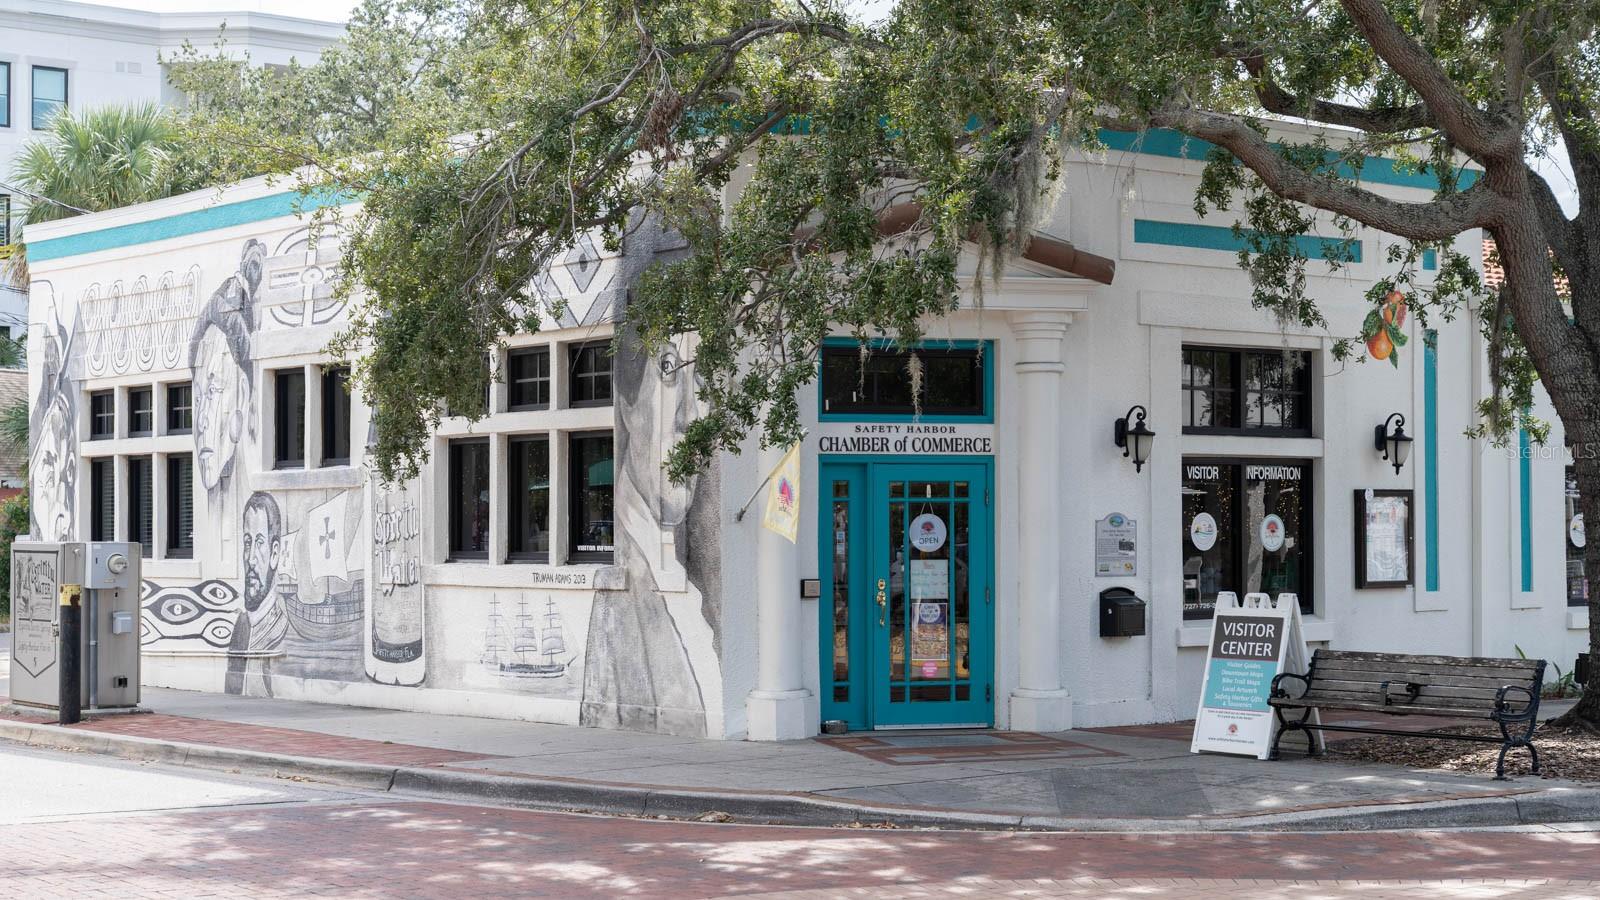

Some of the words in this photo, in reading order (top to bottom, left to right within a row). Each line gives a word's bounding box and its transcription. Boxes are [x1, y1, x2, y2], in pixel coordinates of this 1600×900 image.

[854, 424, 901, 433] SAFETY
[906, 425, 957, 434] HARBOR
[818, 436, 890, 453] CHAMBER
[894, 435, 908, 453] of
[911, 437, 992, 453] COMMERCE
[1186, 465, 1219, 480] VISITOR
[918, 536, 939, 545] OPEN
[577, 544, 596, 552] VISITOR
[532, 572, 554, 584] TRUMAN
[554, 573, 572, 585] ADAMS
[1222, 621, 1275, 639] VISITOR
[1220, 640, 1273, 657] CENTER
